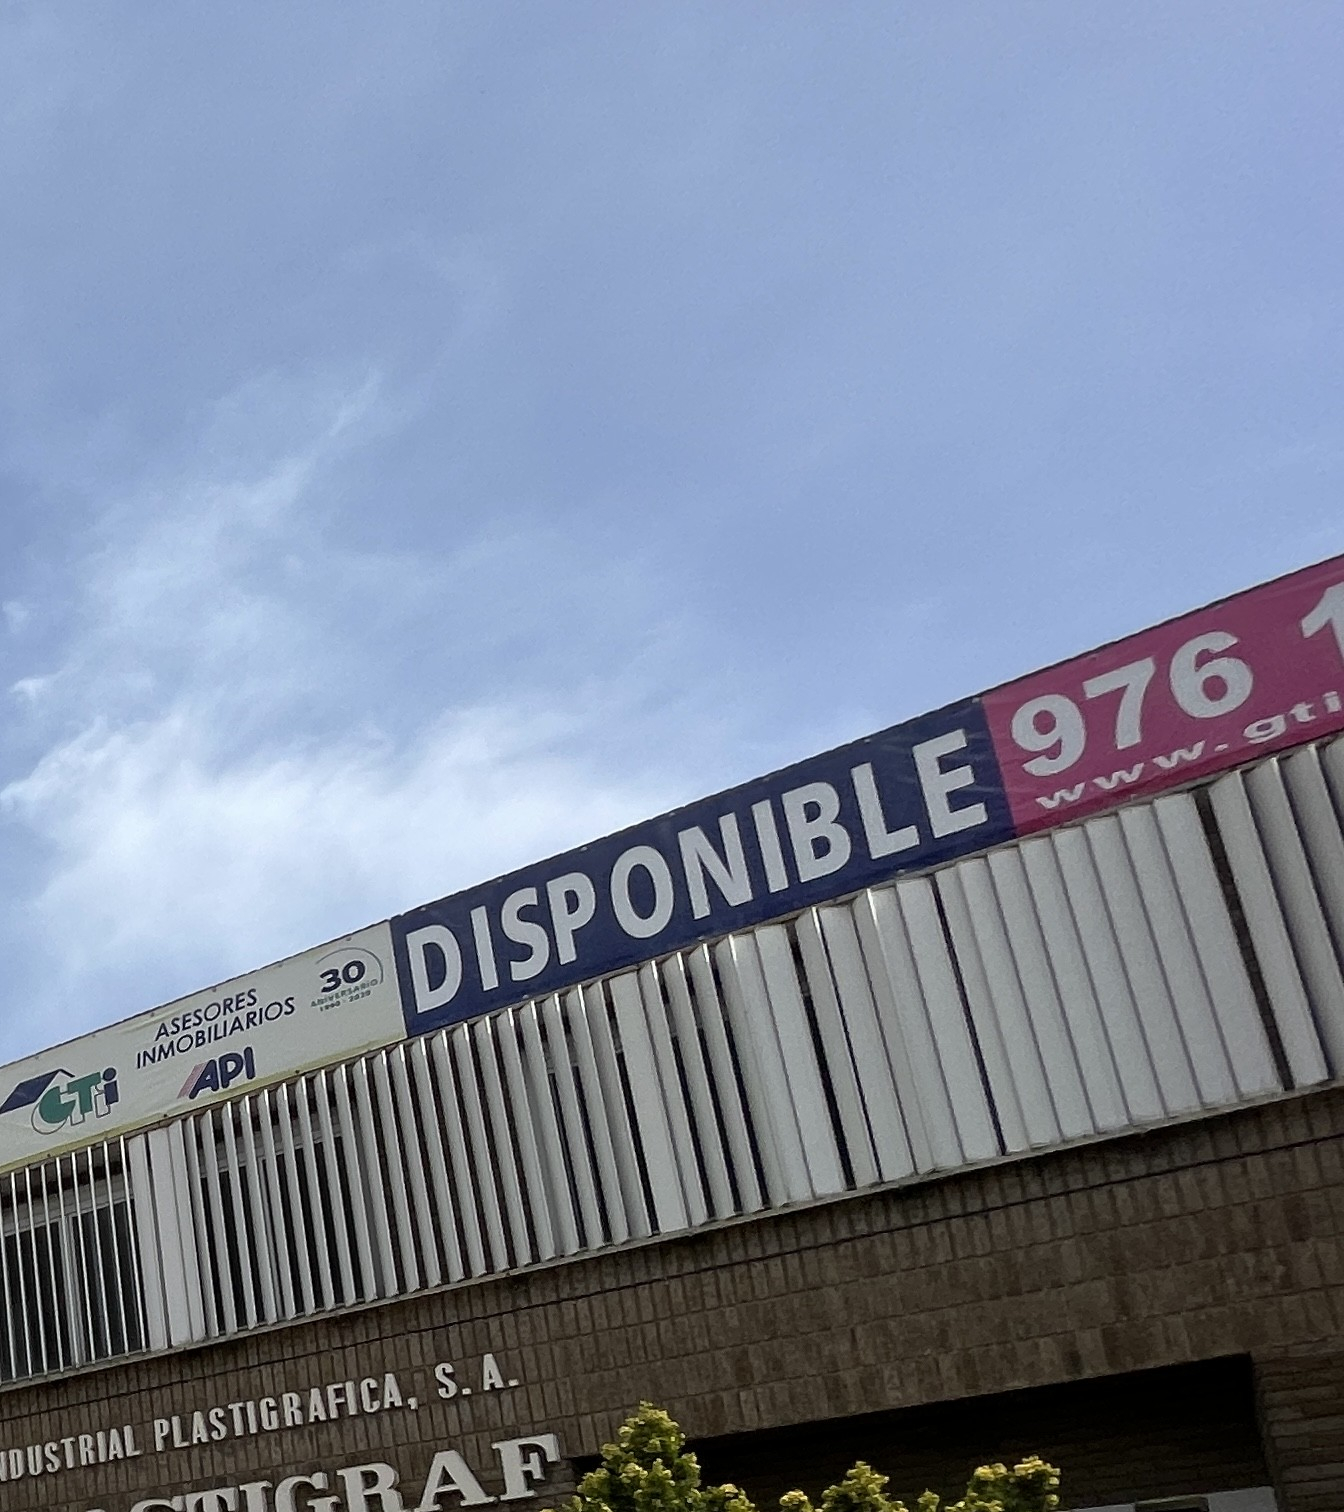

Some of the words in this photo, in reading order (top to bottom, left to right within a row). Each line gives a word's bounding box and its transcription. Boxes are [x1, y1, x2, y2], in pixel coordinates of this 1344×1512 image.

[1011, 631, 1253, 777] 976
[407, 729, 988, 1015] DISPONIBLE
[320, 960, 366, 993] 30
[137, 997, 296, 1069] INMOBILIARIOS
[154, 988, 258, 1042] ASESORES
[188, 1046, 256, 1100] API
[153, 1373, 420, 1452] PLASTIGRAFICA,
